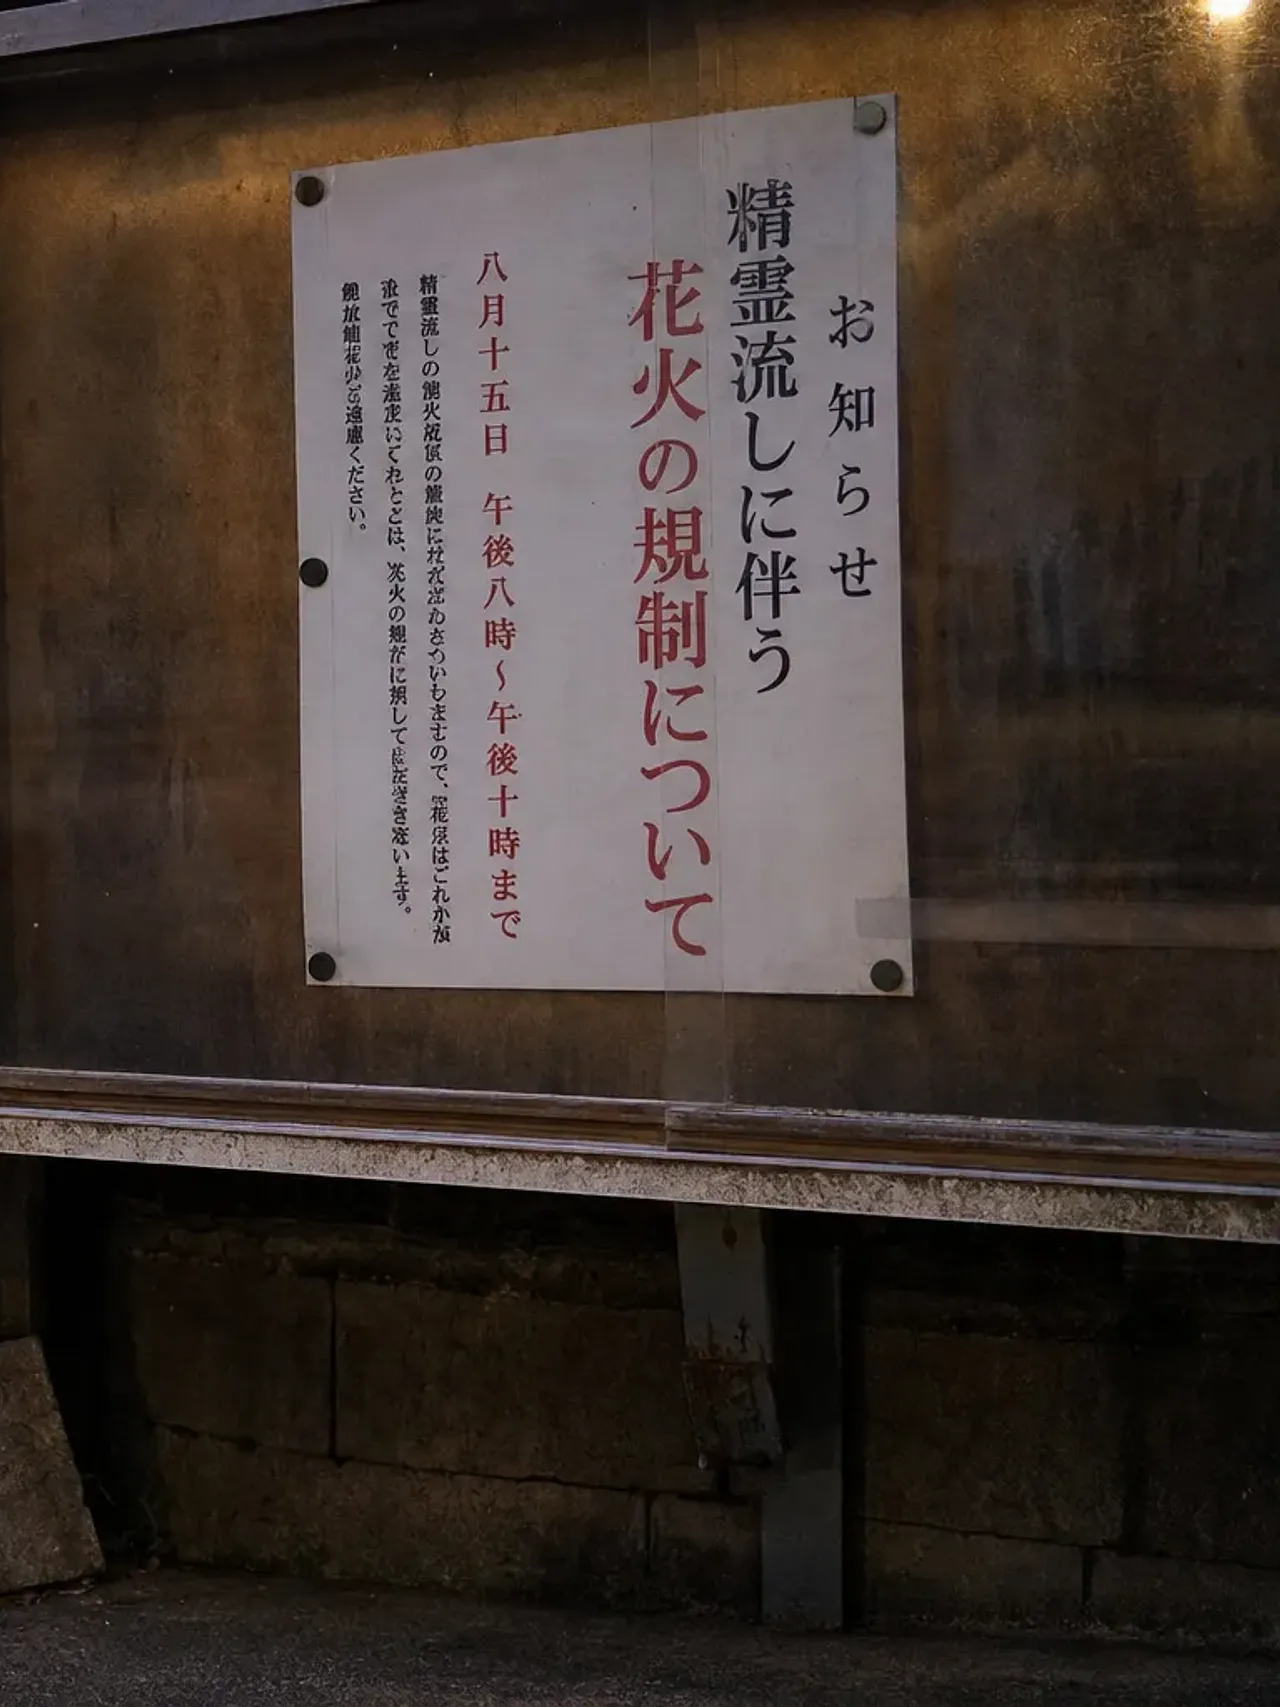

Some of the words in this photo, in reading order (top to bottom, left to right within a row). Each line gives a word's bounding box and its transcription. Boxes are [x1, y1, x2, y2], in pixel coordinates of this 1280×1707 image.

[476, 251, 511, 457] 八月十五日
[725, 178, 802, 695] 精霊流しに伴う
[827, 294, 878, 598] お知らせ
[629, 258, 714, 957] 花火の規制について
